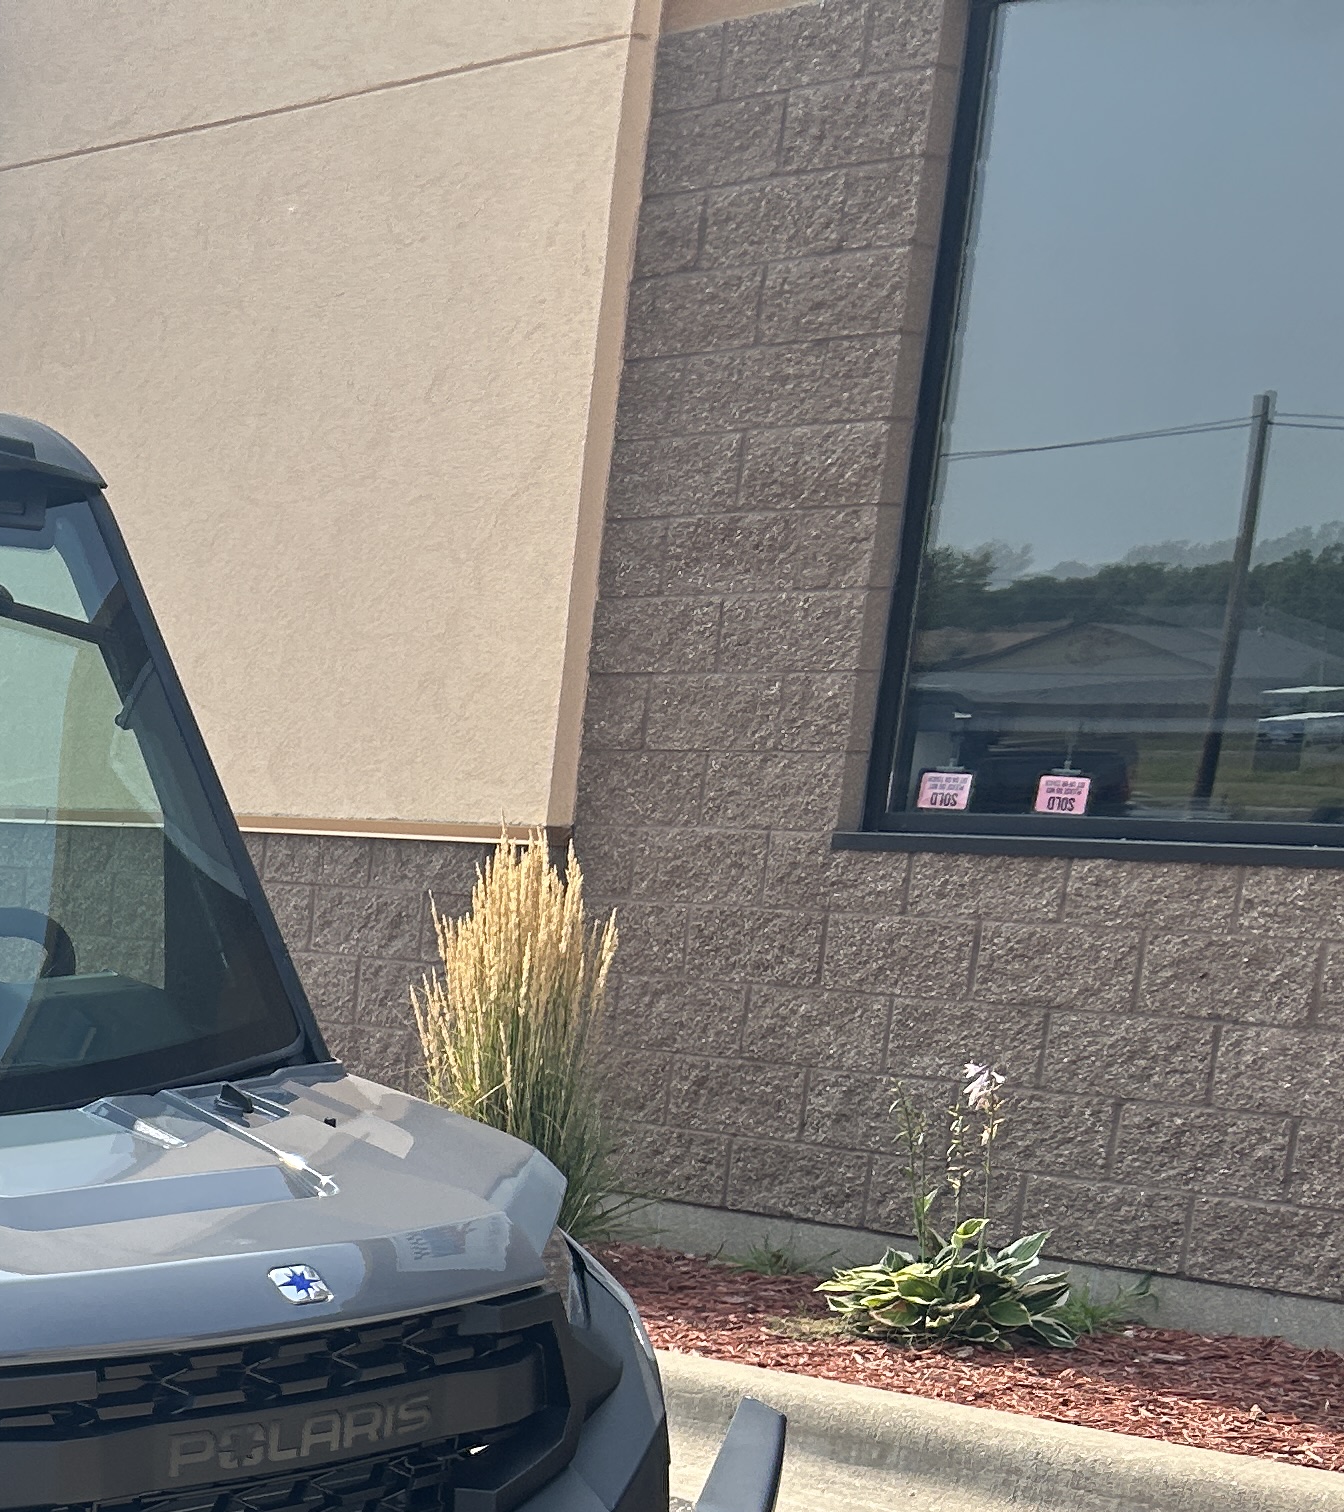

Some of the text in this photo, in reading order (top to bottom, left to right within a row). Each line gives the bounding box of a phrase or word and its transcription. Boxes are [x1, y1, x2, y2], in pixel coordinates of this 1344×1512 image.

[930, 792, 958, 807] SOLD
[1047, 796, 1075, 812] SOLD
[169, 1394, 432, 1478] POLARIS
